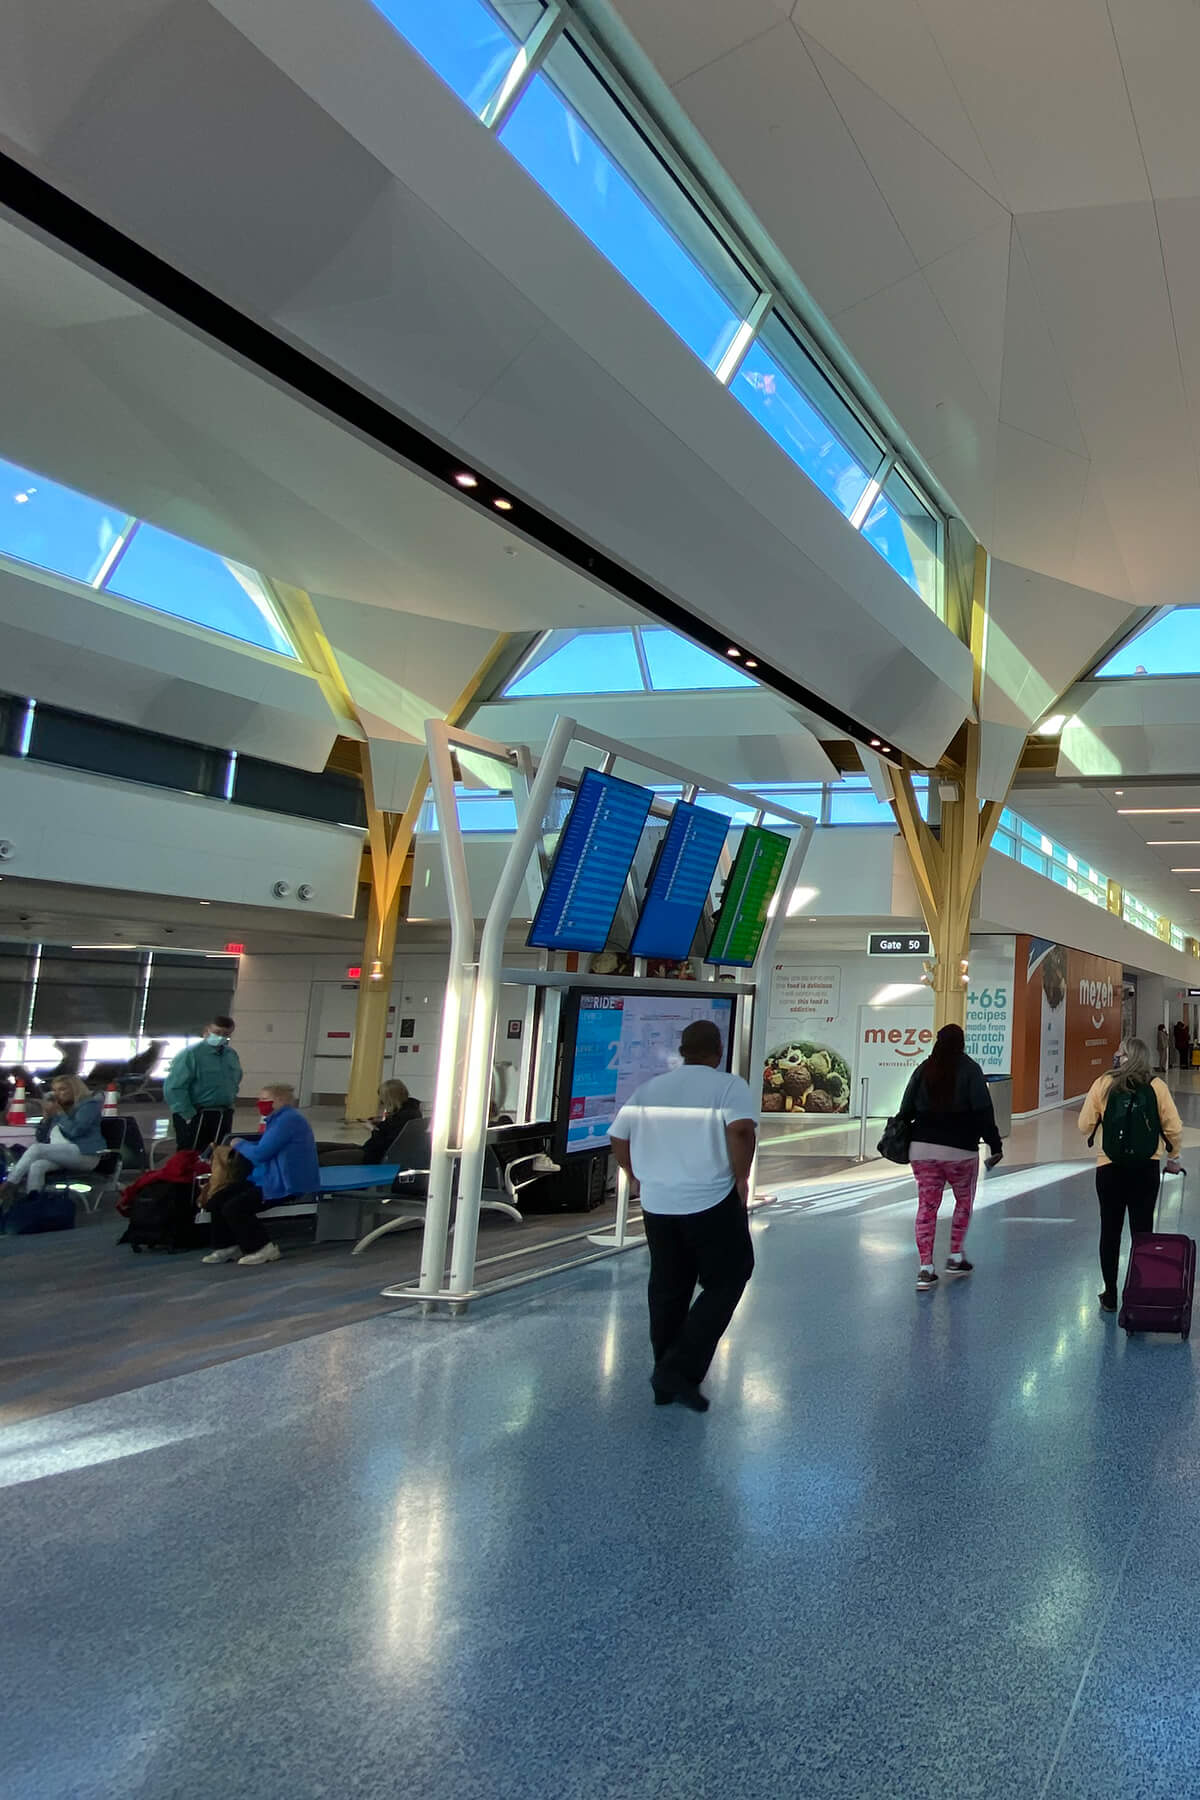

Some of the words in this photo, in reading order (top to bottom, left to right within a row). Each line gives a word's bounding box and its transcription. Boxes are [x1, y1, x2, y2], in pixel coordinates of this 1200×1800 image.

[879, 940, 902, 950] Gate
[908, 940, 920, 950] 50
[967, 988, 1007, 1008] +65
[1079, 975, 1113, 1009] mezeh
[593, 996, 615, 1009] RIDE
[966, 1009, 1007, 1022] recipes
[988, 1023, 1006, 1031] from
[864, 1028, 933, 1045] meze
[965, 1032, 1004, 1042] scratch
[982, 1043, 1004, 1057] day
[988, 1056, 1003, 1066] day
